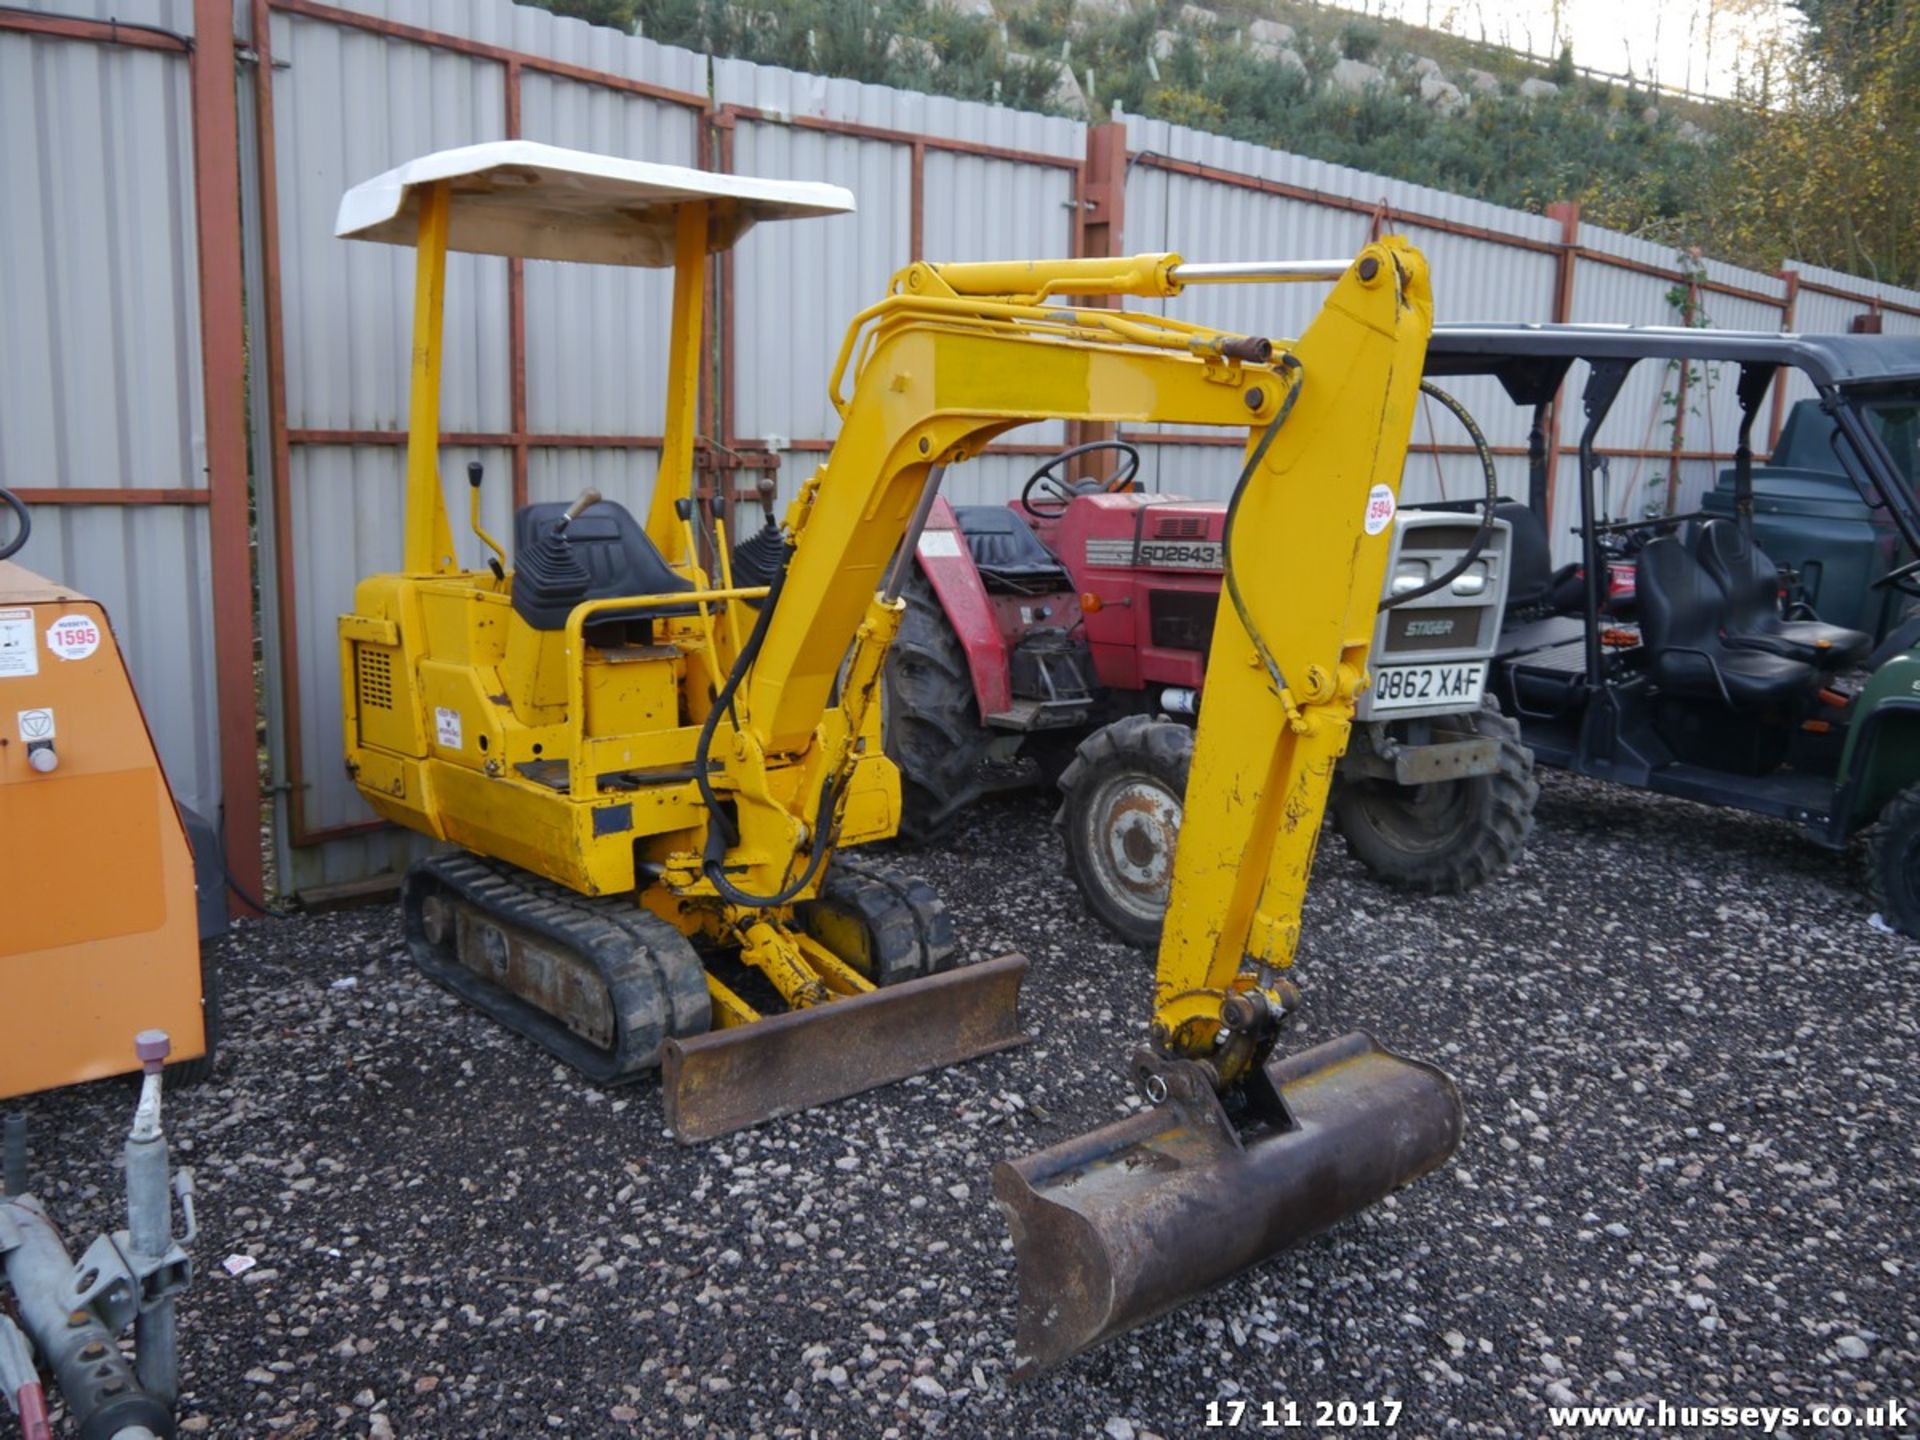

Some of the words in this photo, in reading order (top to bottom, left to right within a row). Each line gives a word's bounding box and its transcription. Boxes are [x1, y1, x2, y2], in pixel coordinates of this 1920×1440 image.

[1371, 501, 1392, 519] 594
[1141, 546, 1215, 563] SD2643
[55, 628, 97, 646] 1595
[1404, 620, 1455, 636] STIGER
[1376, 670, 1433, 700] Q862
[1436, 668, 1481, 697] XAF
